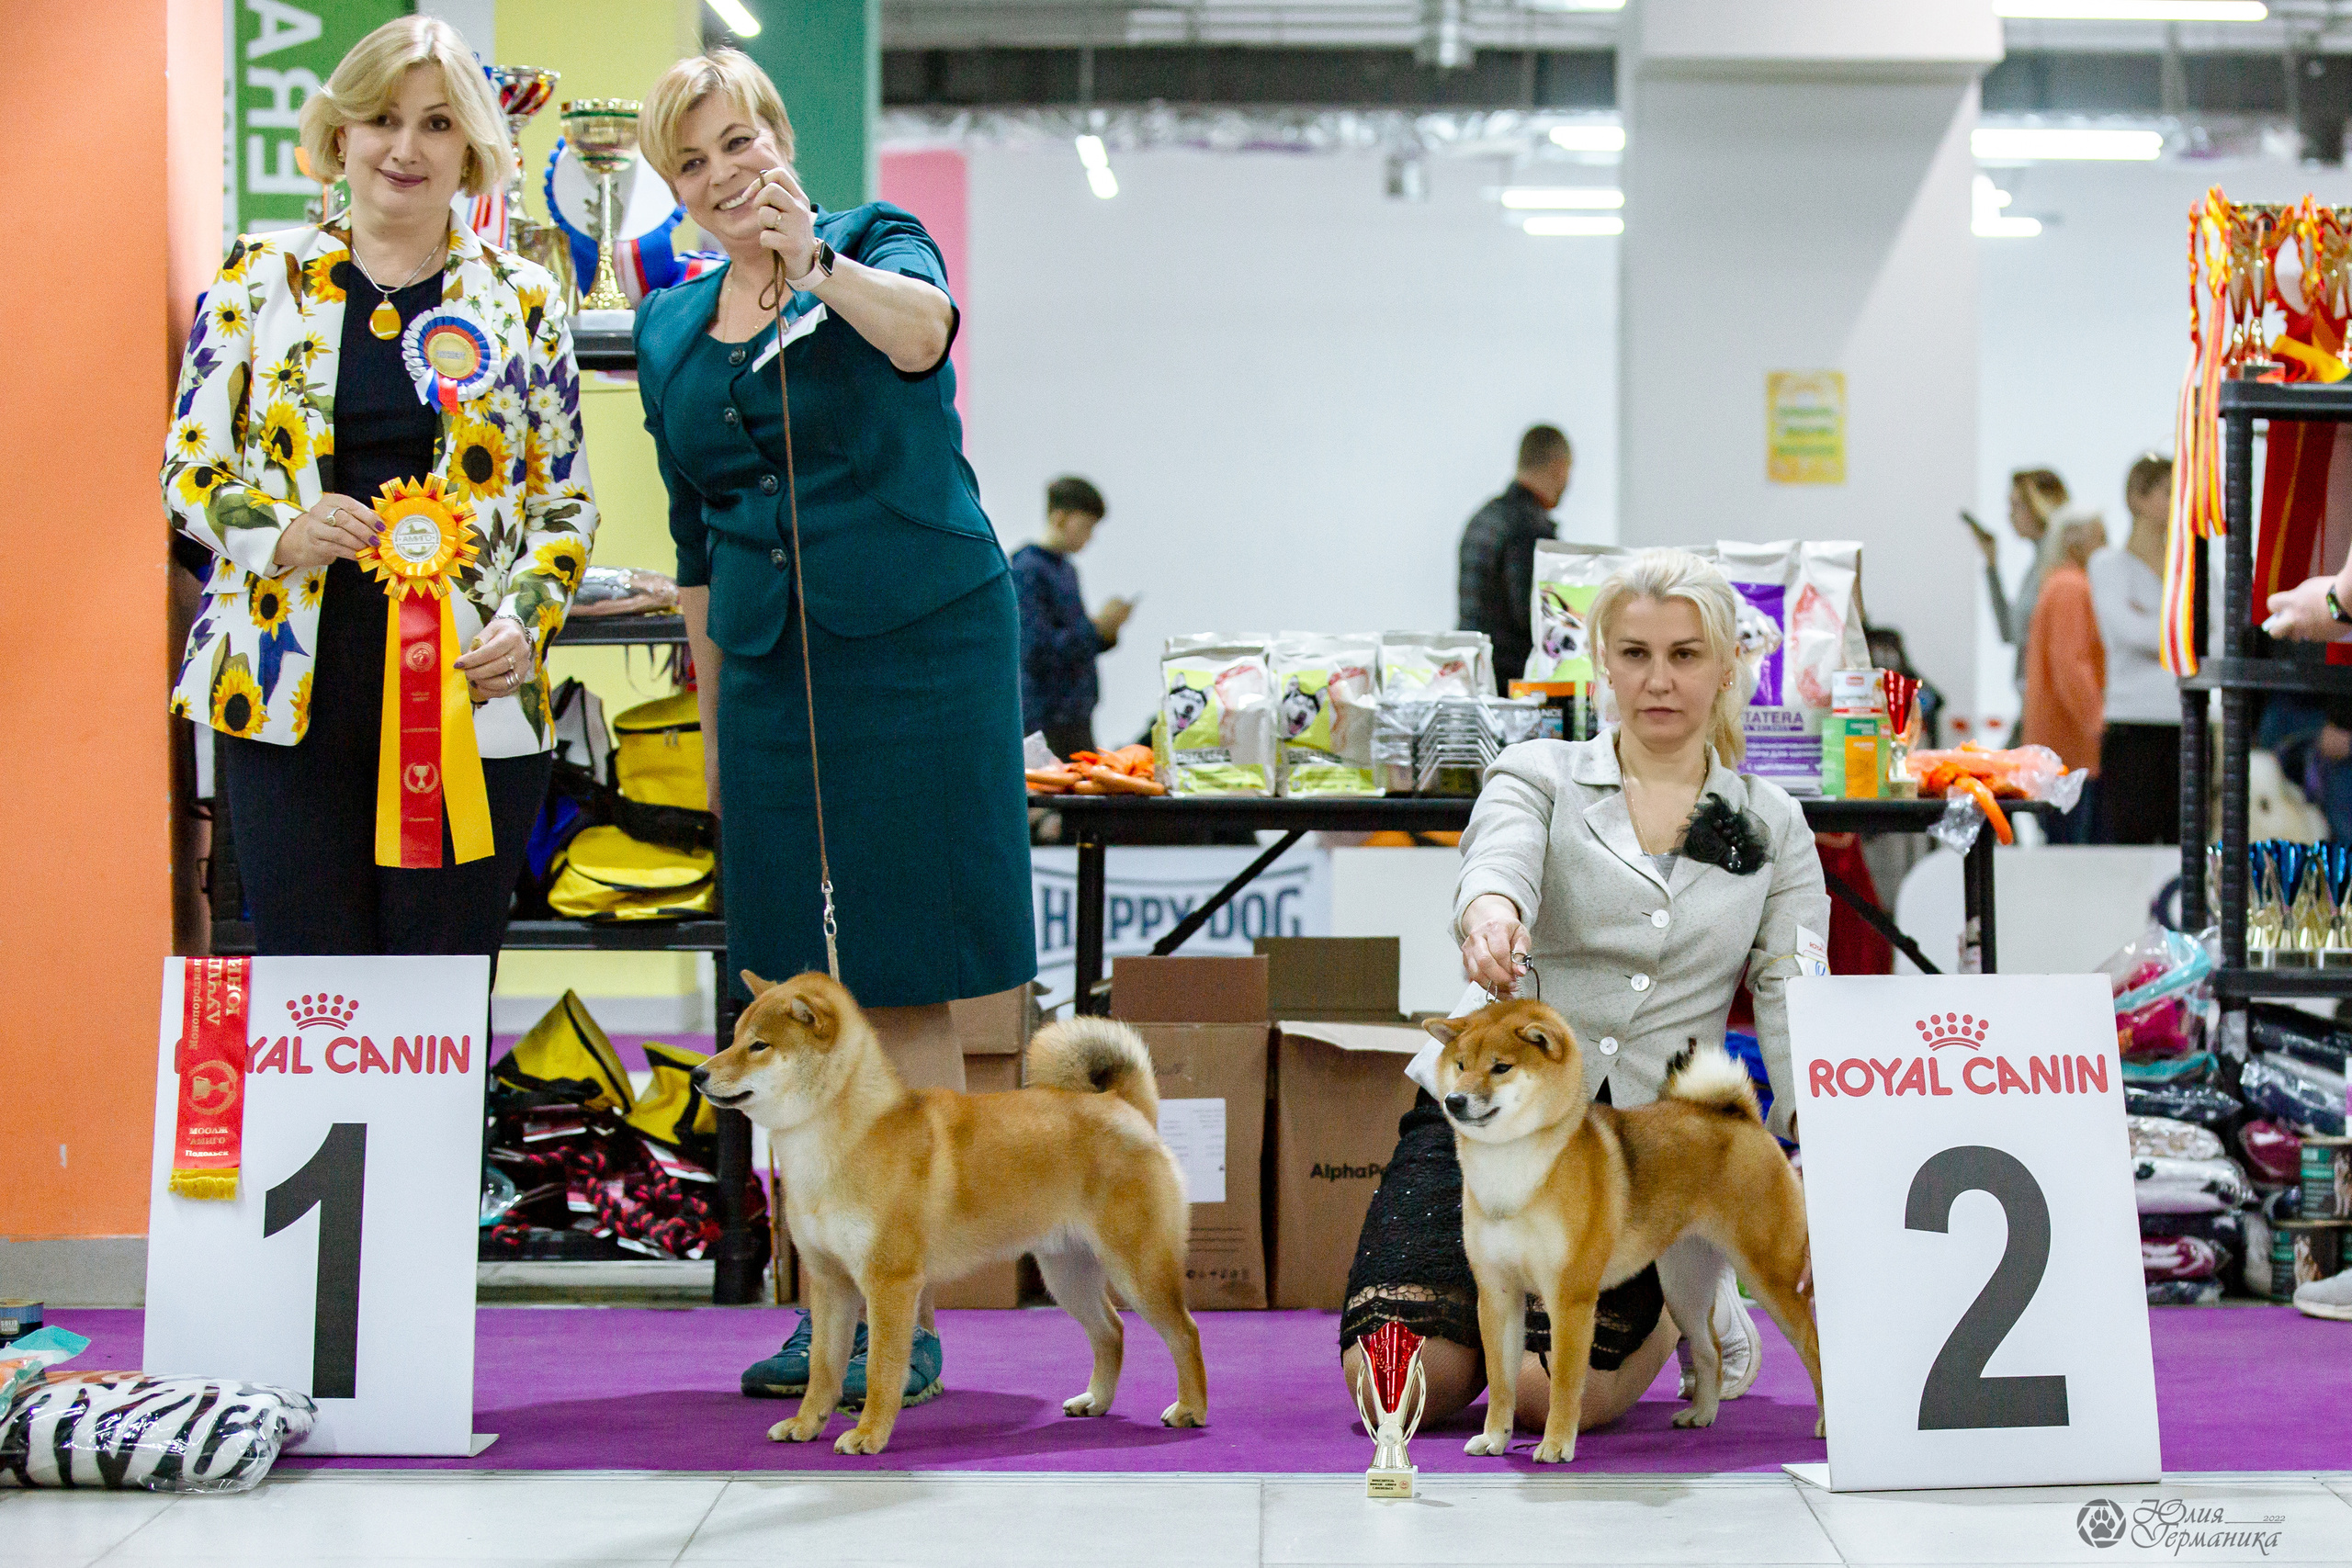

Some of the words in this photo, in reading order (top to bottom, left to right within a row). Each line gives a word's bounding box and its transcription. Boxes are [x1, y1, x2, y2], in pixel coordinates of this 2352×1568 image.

[1041, 886, 1193, 952] HPPY
[1208, 886, 1301, 941] DOG
[324, 1035, 470, 1074] CANIN
[1808, 1057, 1953, 1098] ROYAL
[1963, 1054, 2109, 1095] CANIN
[264, 1122, 367, 1399] 1
[1905, 1145, 2070, 1430] 2
